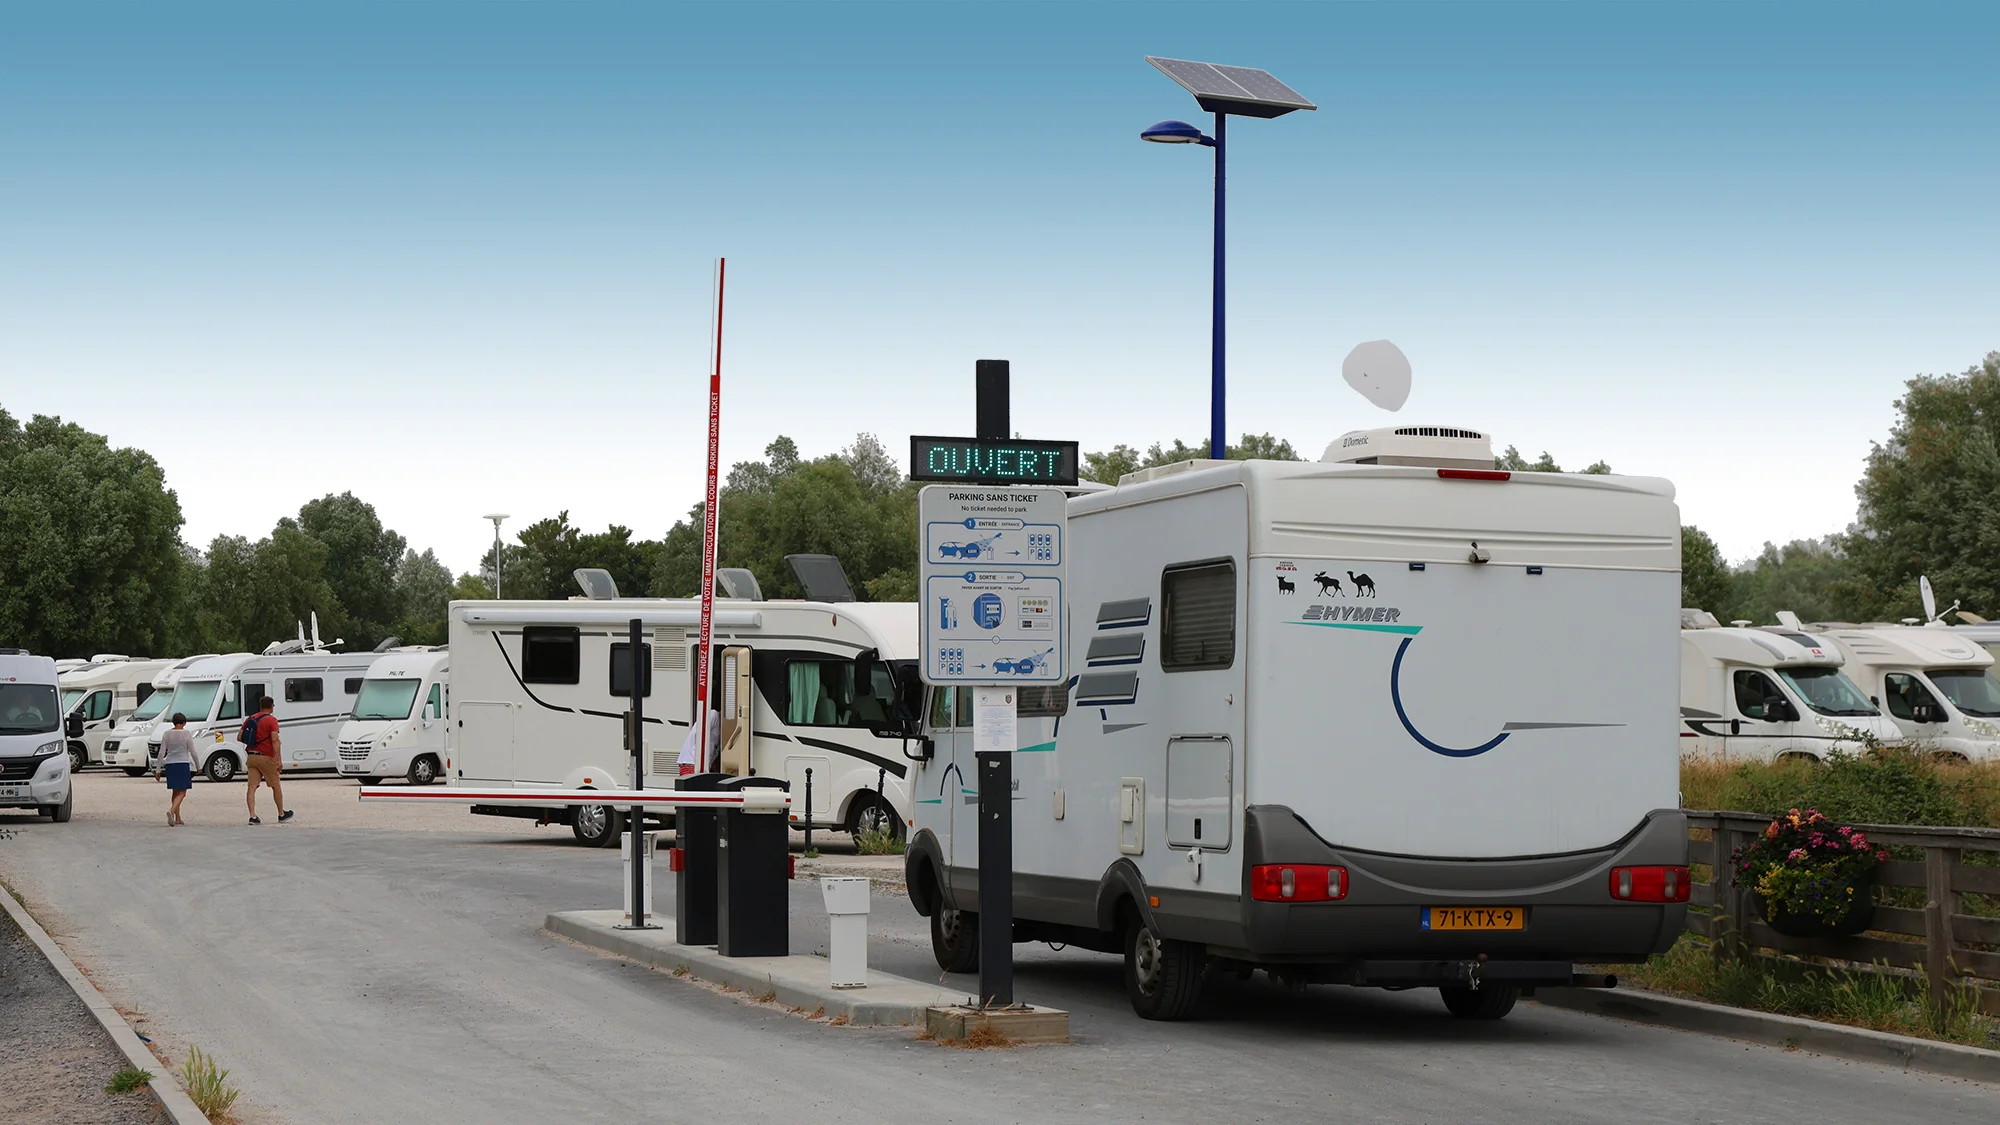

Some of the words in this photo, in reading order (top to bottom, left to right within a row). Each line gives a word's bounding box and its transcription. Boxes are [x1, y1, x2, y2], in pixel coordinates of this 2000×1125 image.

[710, 417, 718, 438] SANS
[709, 439, 717, 470] PARKING
[928, 446, 1060, 477] OUVERT
[708, 501, 715, 511] EN
[949, 492, 985, 502] PARKING
[986, 493, 1008, 502] SANS
[1010, 494, 1038, 503] TICKET
[1014, 506, 1027, 514] park
[705, 512, 714, 576] IMMATRICULATION
[703, 601, 709, 612] DE
[1323, 606, 1401, 623] HYMER
[701, 613, 709, 645] LECTURE
[700, 650, 708, 686] ATTENDEZ
[1439, 909, 1514, 927] 71-KTX-9
